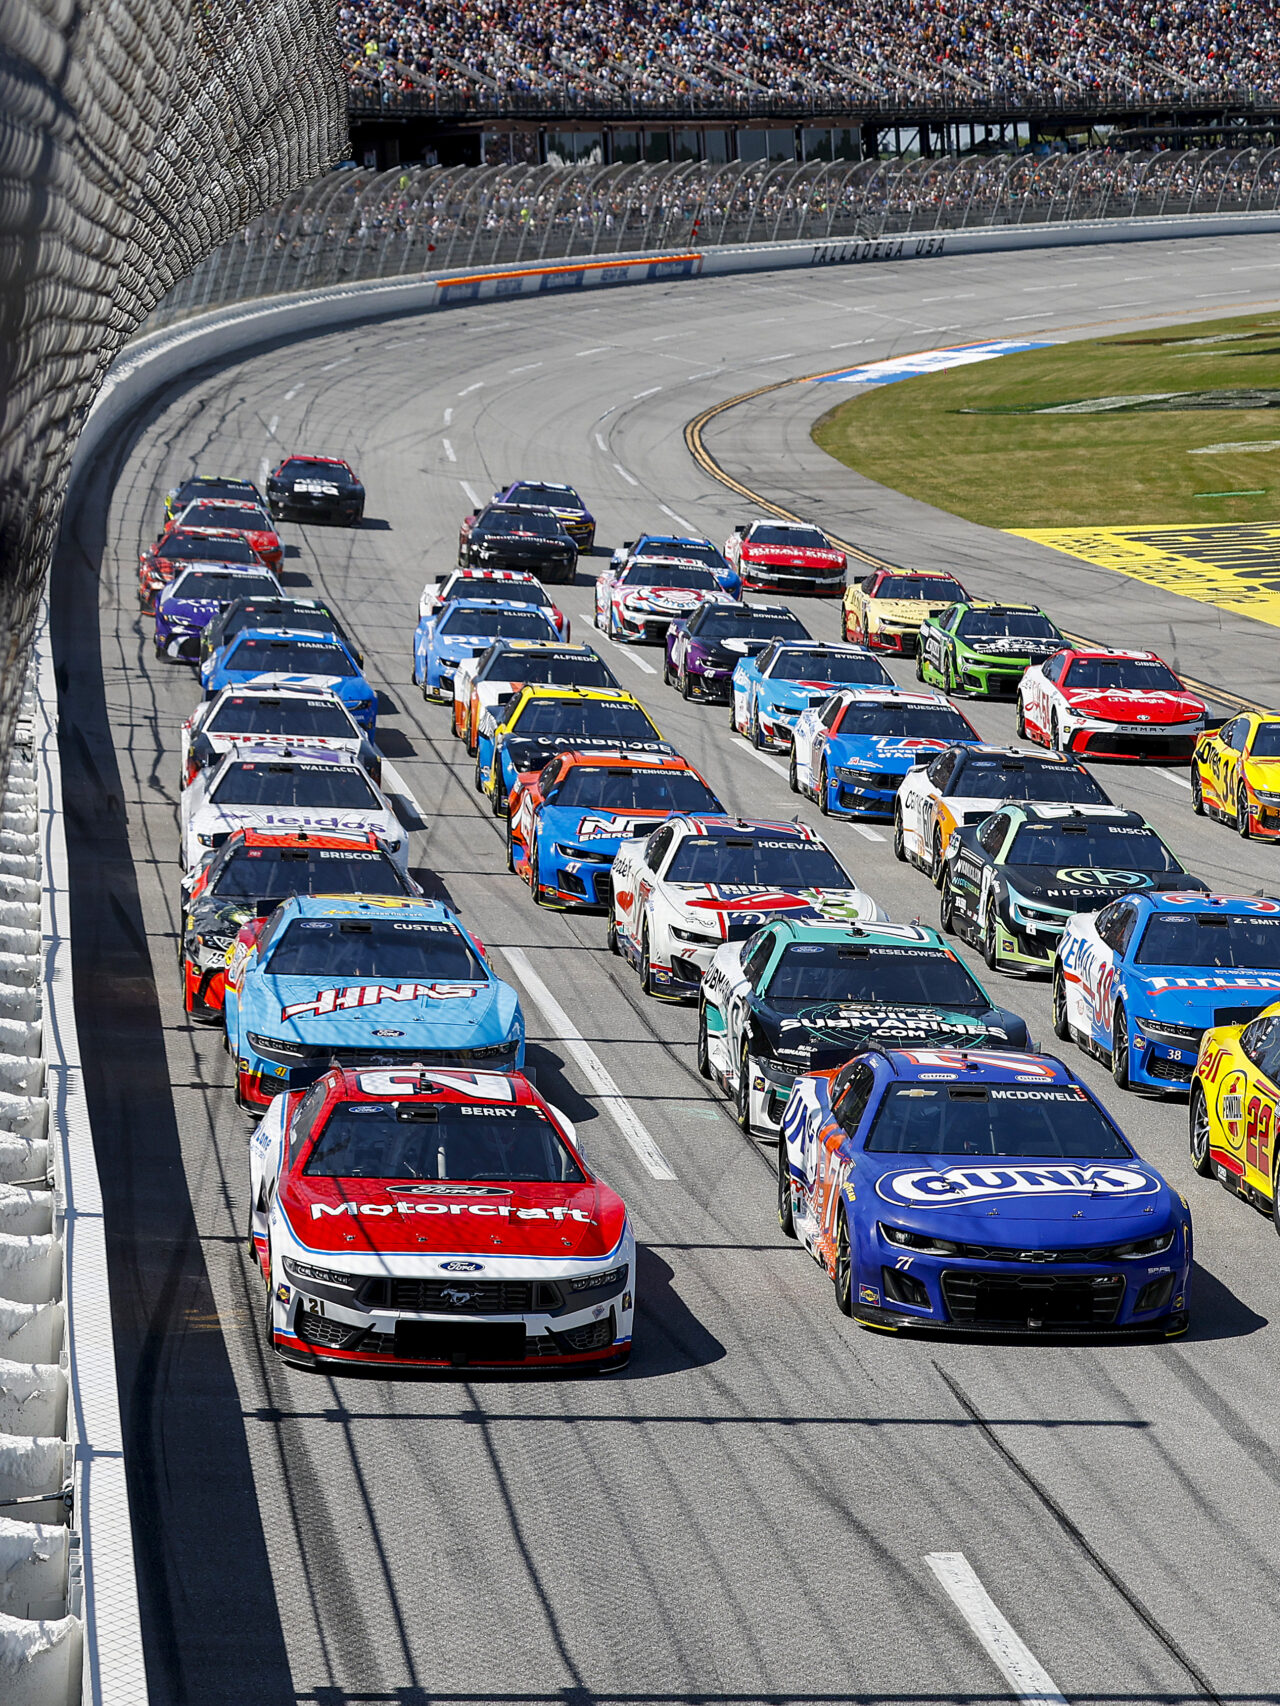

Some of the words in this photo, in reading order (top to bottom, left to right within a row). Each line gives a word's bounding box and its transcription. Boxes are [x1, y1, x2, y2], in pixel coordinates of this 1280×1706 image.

[811, 241, 904, 263] TALLADEGA
[915, 238, 946, 256] USA
[1170, 584, 1271, 605] Pine
[297, 642, 336, 650] HAMLIN
[553, 653, 597, 662] ALFREDO
[601, 702, 636, 711] HALEY
[300, 764, 355, 773] WALLACE
[1041, 764, 1078, 772] PREECE
[854, 787, 865, 795] 17
[266, 815, 387, 834] leidos
[1108, 826, 1151, 836] BUSCH
[320, 851, 382, 861] BRISCOE
[565, 863, 582, 874] 47
[393, 923, 448, 933] CUSTER
[681, 948, 697, 958] 77
[869, 949, 950, 958] KESELOWSKI
[839, 1011, 943, 1021] BUILD
[376, 1029, 403, 1037] Ford
[780, 1018, 1009, 1040] SUBMARINES
[871, 1029, 926, 1038] .COM
[1167, 1050, 1182, 1061] 38
[274, 1066, 287, 1077] 41
[1019, 1075, 1049, 1083] GUNK
[991, 1089, 1086, 1102] MCDOWELL
[461, 1106, 518, 1118] BERRY
[1246, 1096, 1272, 1177] 22
[908, 1168, 1128, 1198] GUNK
[411, 1184, 491, 1196] Ford
[311, 1200, 594, 1224] Motorcraft
[446, 1261, 479, 1272] Ford
[896, 1255, 915, 1271] 71
[309, 1299, 326, 1316] 21
